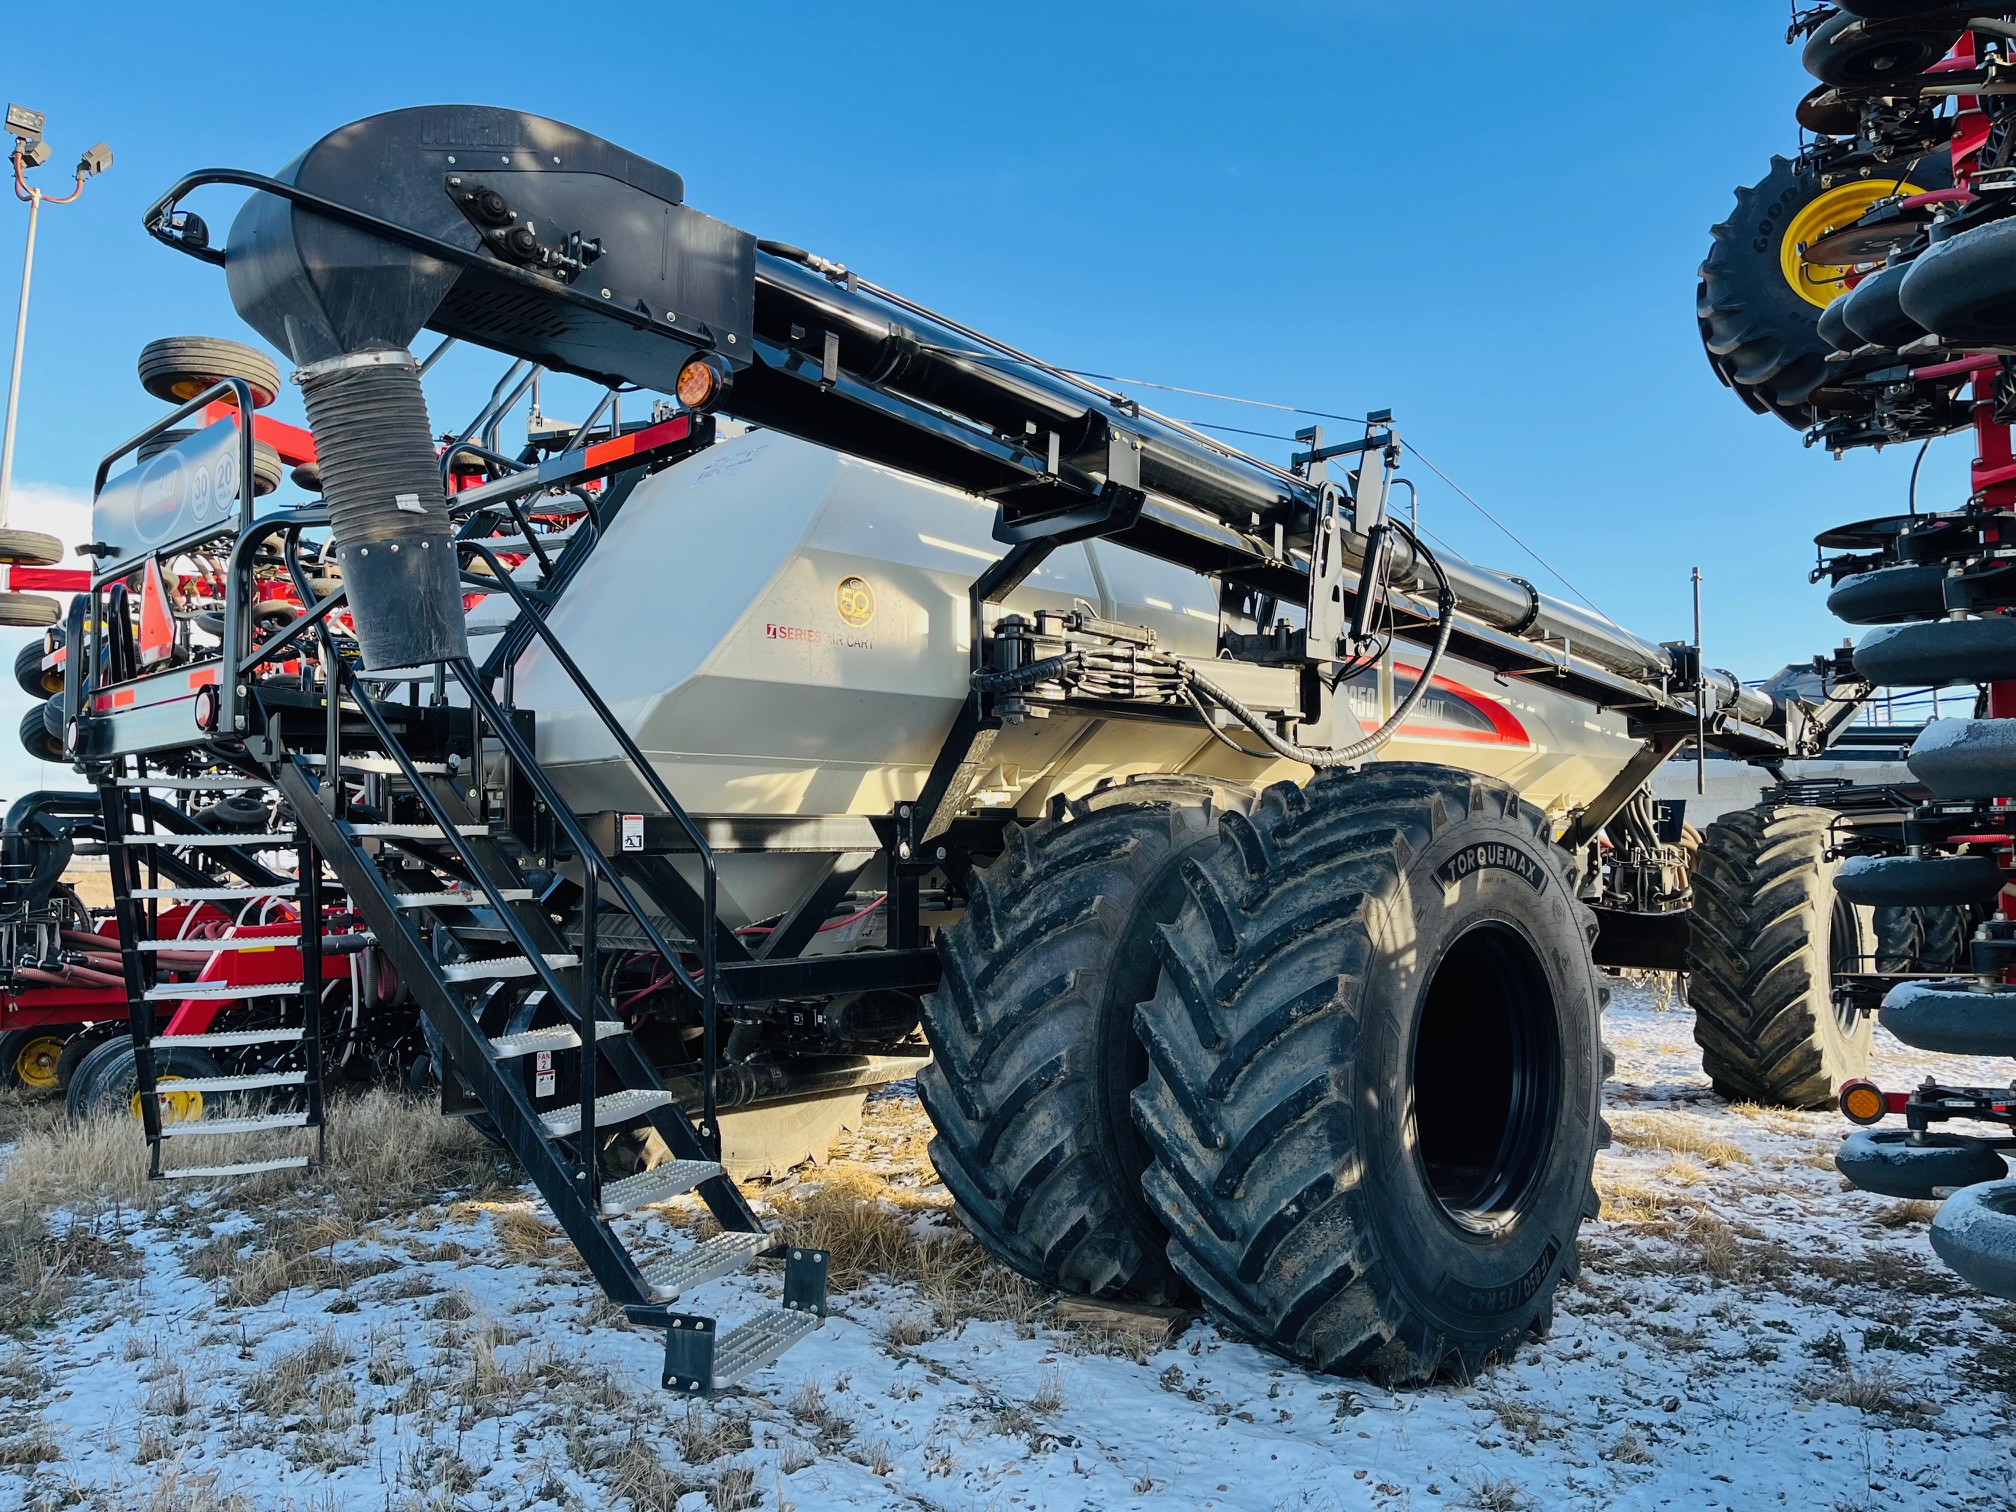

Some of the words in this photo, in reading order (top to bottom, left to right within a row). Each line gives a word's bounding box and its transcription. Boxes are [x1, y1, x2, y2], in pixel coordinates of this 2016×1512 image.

[194, 473, 208, 500] 30
[217, 461, 232, 489] 20
[840, 587, 870, 617] 50
[779, 626, 822, 643] SERIES
[846, 635, 875, 650] CART
[1342, 684, 1377, 719] 950
[1447, 845, 1537, 882] TORQUEMAX
[537, 1053, 551, 1061] FAN
[541, 1060, 547, 1069] 2
